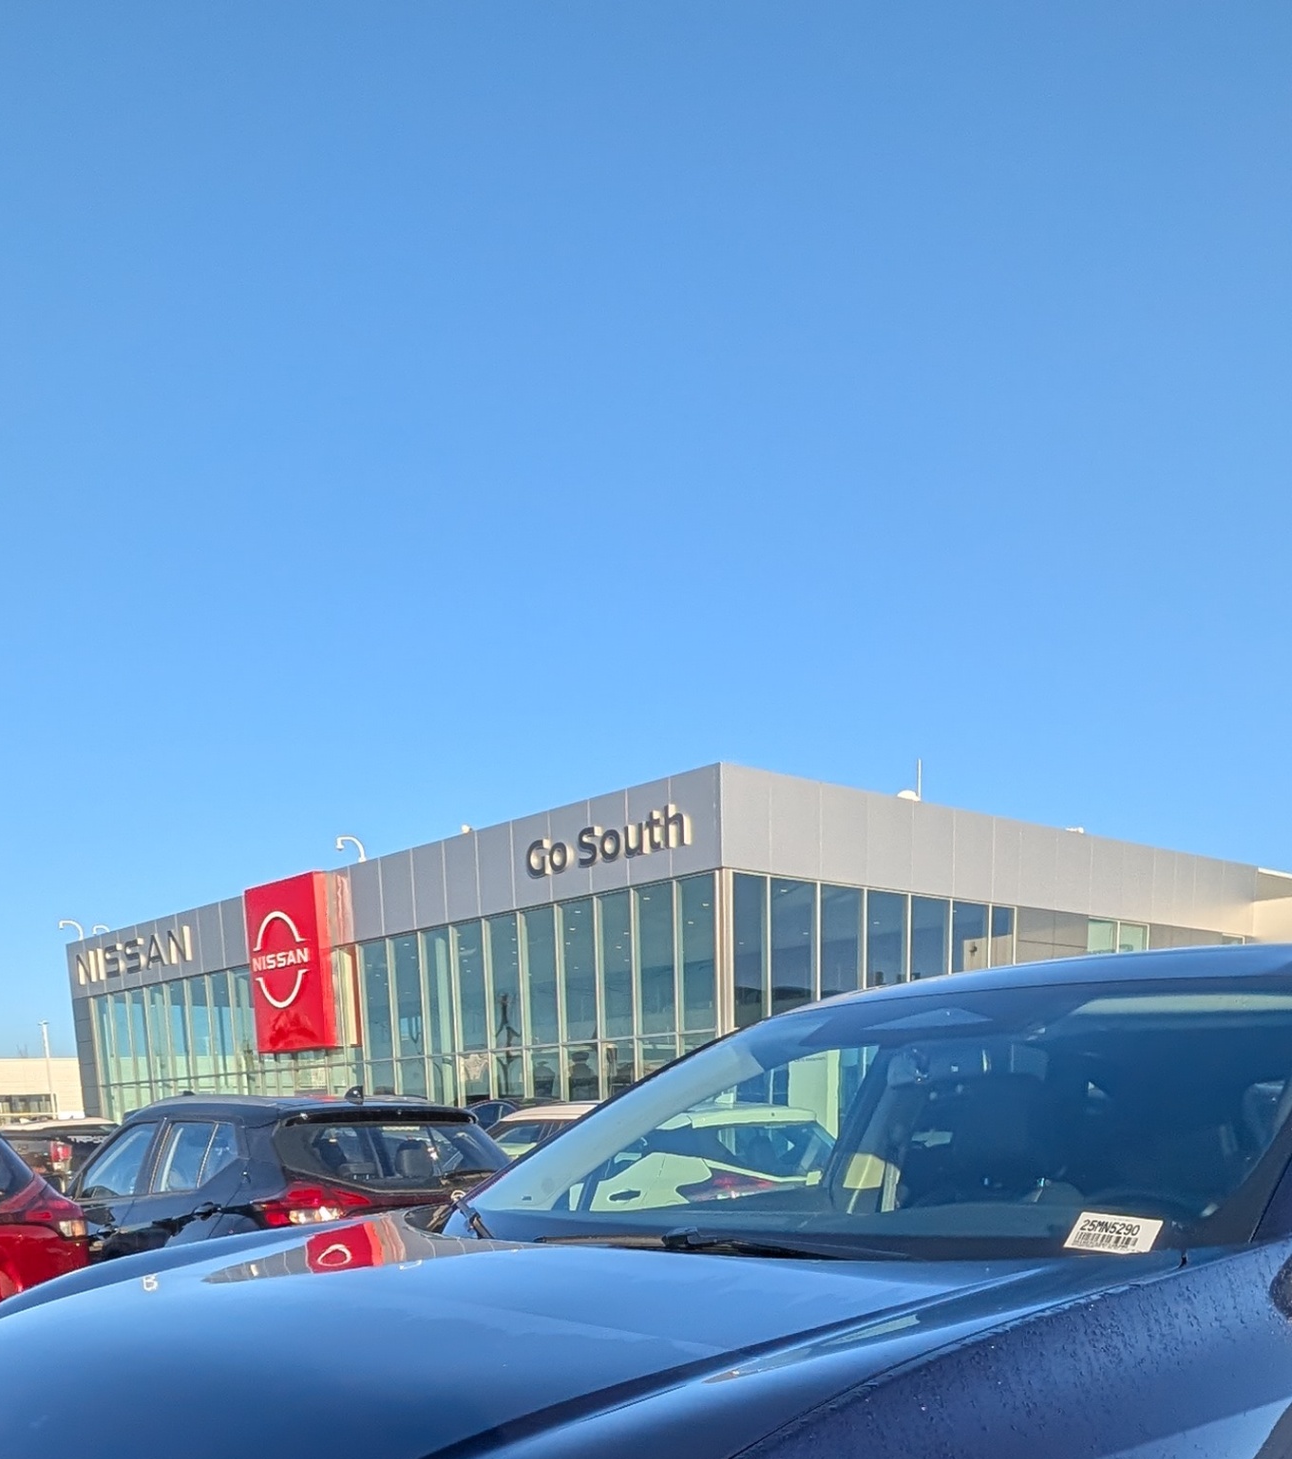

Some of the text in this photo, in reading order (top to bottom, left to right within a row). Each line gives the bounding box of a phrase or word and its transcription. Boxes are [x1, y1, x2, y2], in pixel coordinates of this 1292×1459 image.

[526, 803, 692, 879] Go South
[75, 924, 193, 986] NISSAN
[251, 947, 310, 972] NISSAN
[1079, 1219, 1141, 1237] 25MN5290
